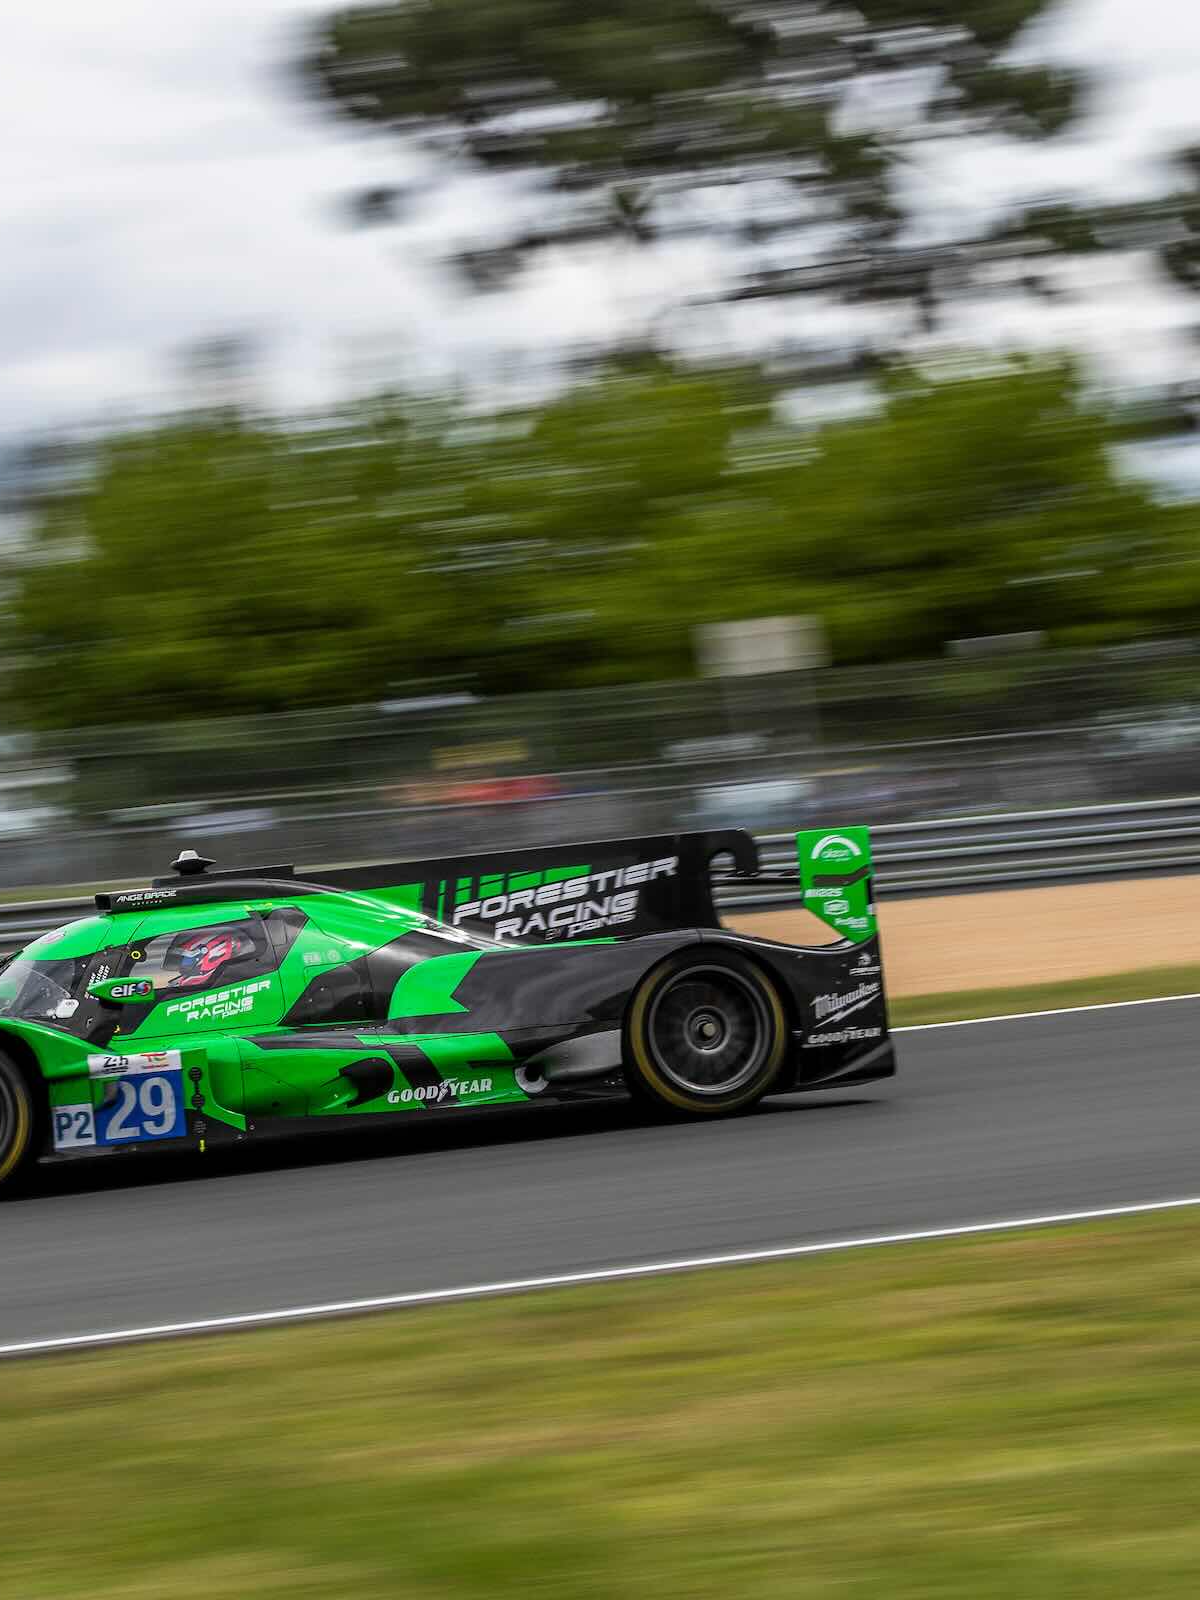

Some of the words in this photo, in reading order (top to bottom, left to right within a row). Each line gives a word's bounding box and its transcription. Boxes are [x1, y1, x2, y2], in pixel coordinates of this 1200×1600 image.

[452, 856, 679, 925] FORESTIER
[494, 890, 639, 941] RACING
[111, 984, 136, 997] elf
[166, 980, 271, 1016] FORESTIER
[186, 995, 253, 1022] RACING
[810, 982, 880, 1019] Milwaukee
[55, 1111, 93, 1140] P2
[105, 1076, 177, 1140] 29
